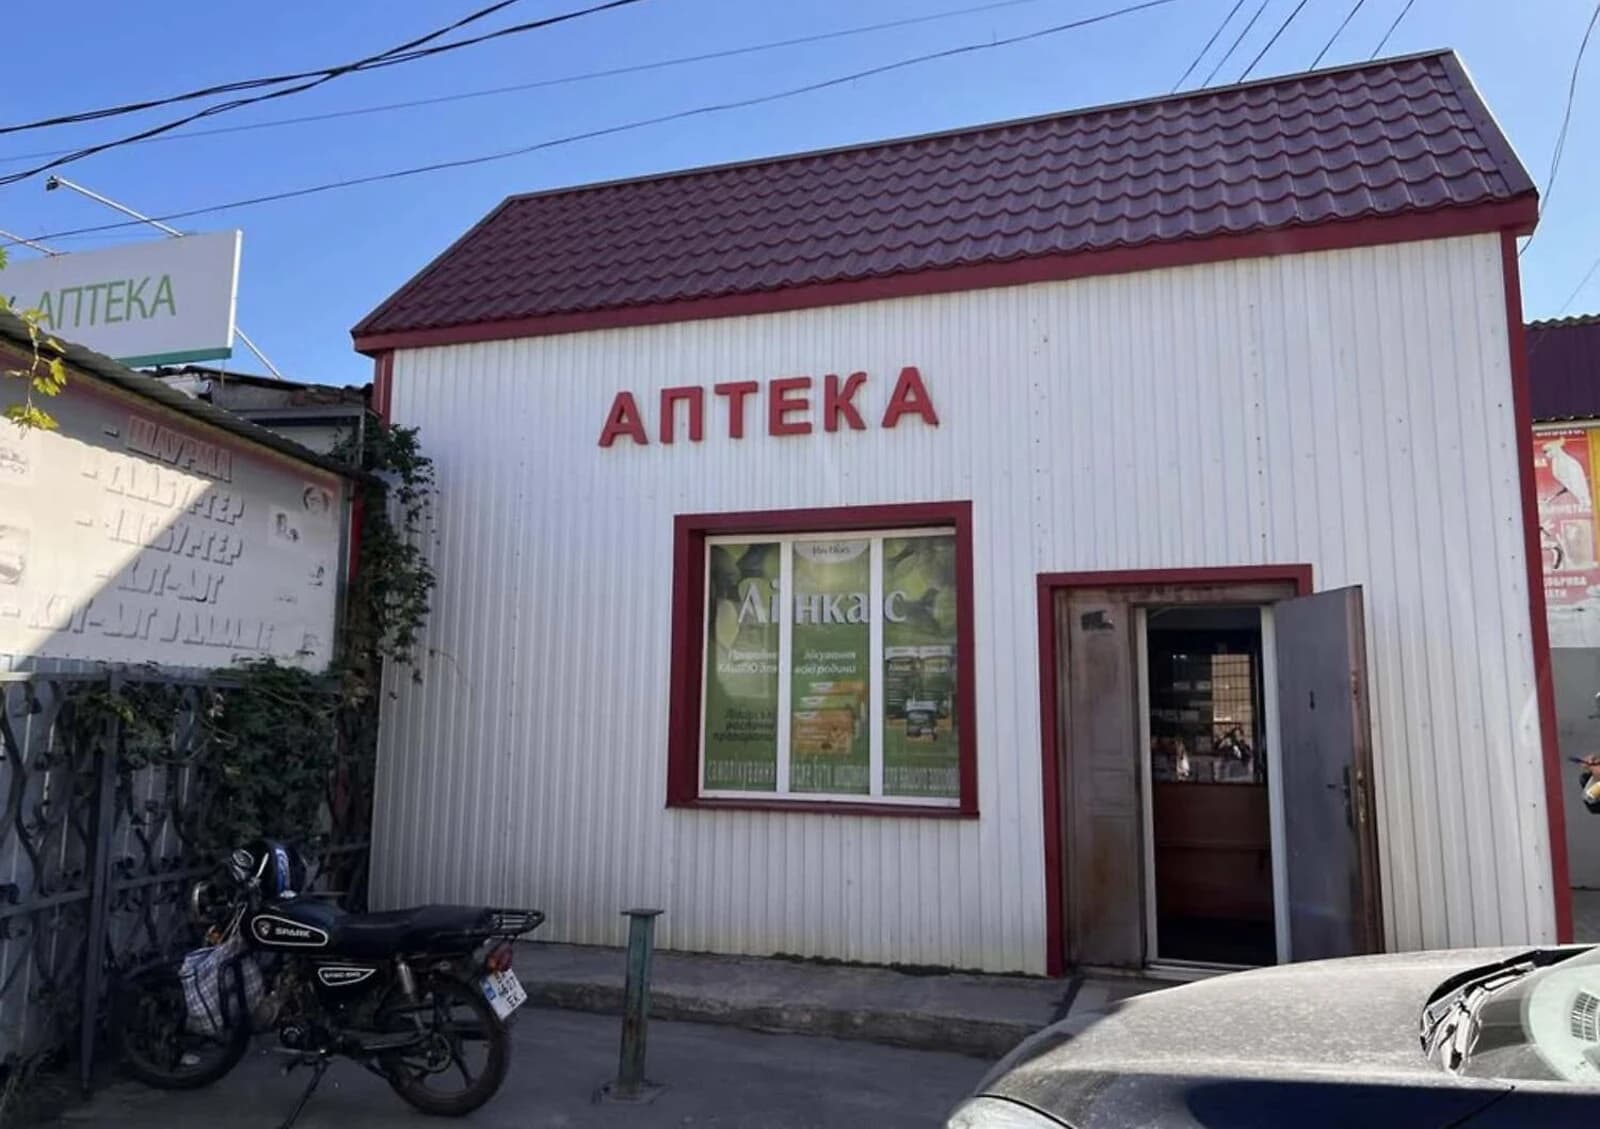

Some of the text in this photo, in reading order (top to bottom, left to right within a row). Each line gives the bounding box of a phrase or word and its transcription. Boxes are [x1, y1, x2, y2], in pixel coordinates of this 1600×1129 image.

[38, 274, 177, 331] АПТЕКА
[598, 366, 940, 448] АПТЕКА
[127, 415, 233, 483] ШАУРМА
[738, 577, 908, 625] Лінкас
[275, 927, 311, 938] SPARK
